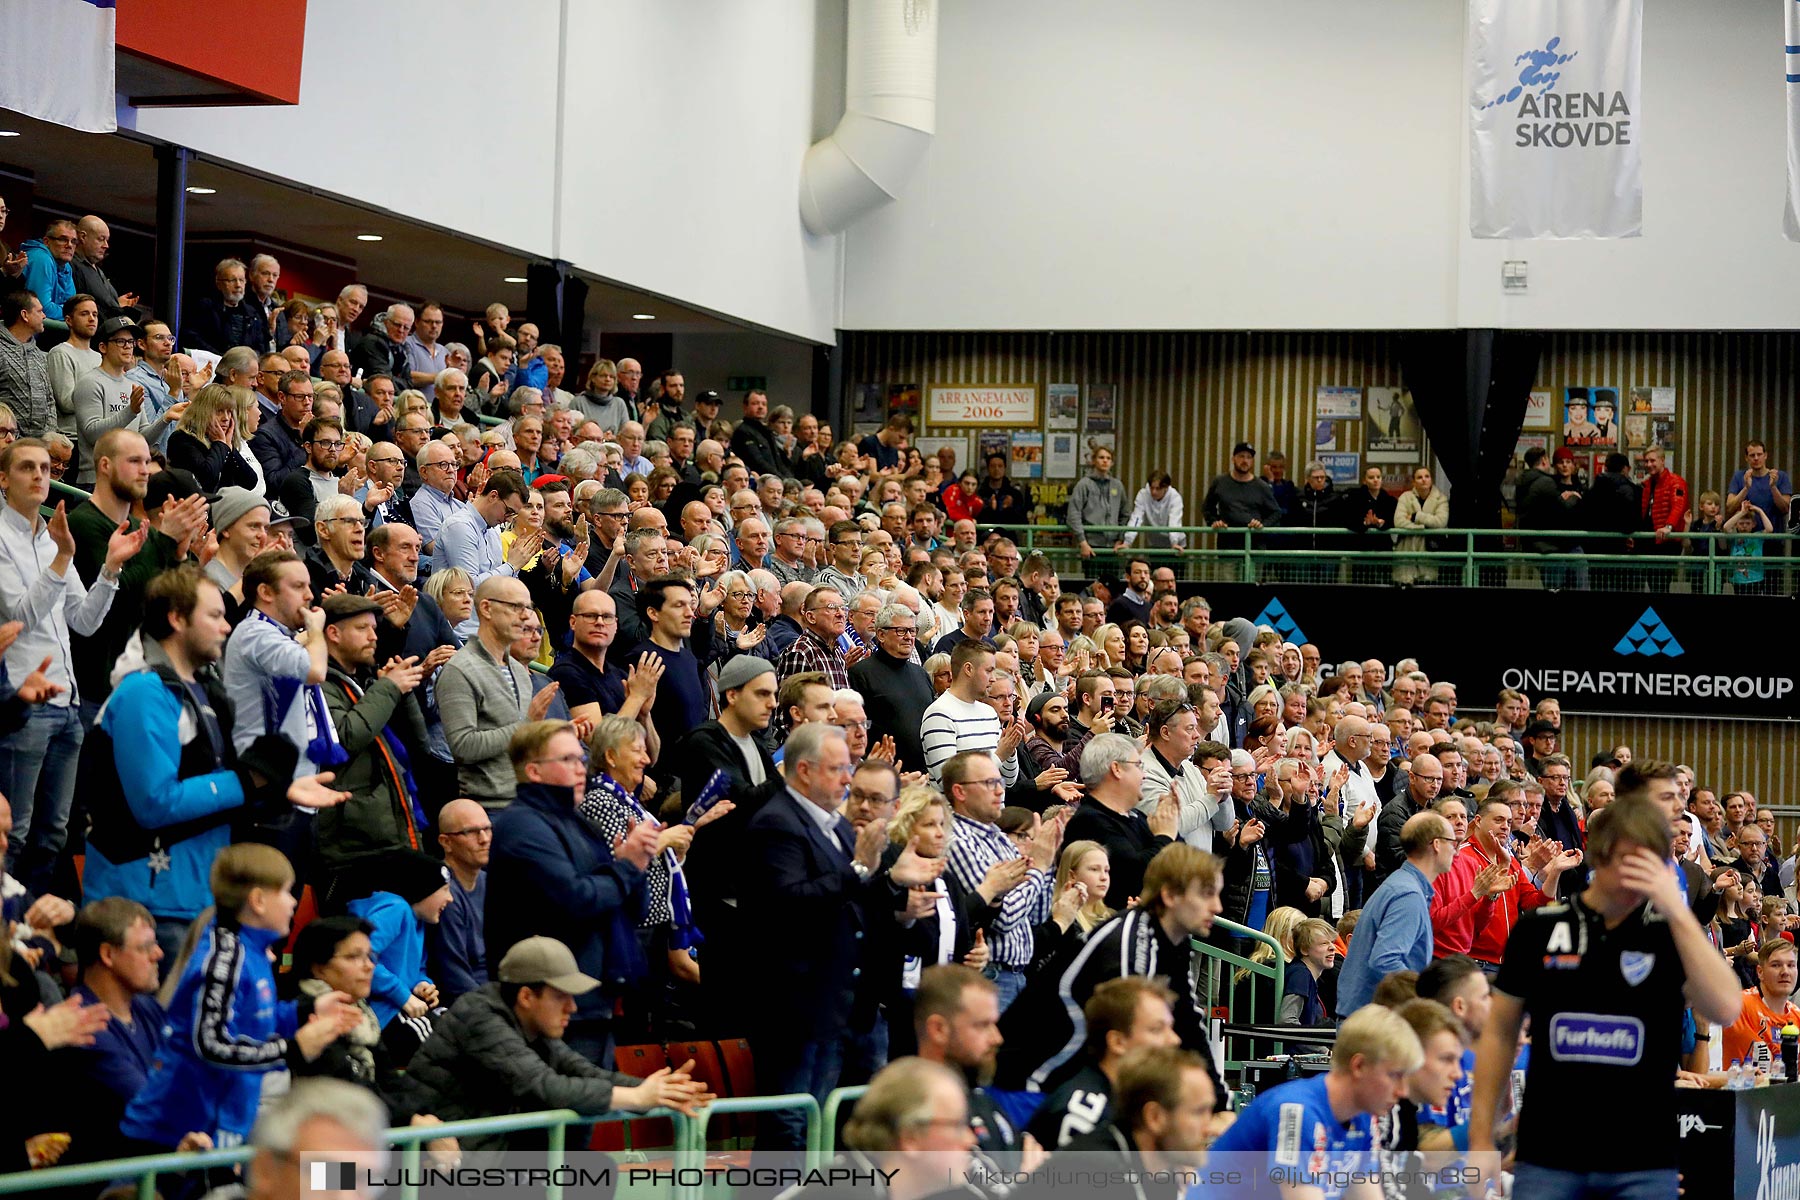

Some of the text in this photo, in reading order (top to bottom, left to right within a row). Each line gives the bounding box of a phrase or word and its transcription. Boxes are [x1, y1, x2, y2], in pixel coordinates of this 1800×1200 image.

[1517, 91, 1631, 119] ARENA
[1515, 121, 1632, 148] SKÖVDE
[938, 391, 1029, 405] ARRANGEMANG
[962, 406, 1004, 418] 2006
[1502, 668, 1794, 699] ONEPARTNERGROUP
[1546, 921, 1572, 953] A
[1556, 1025, 1636, 1051] Furhoffs
